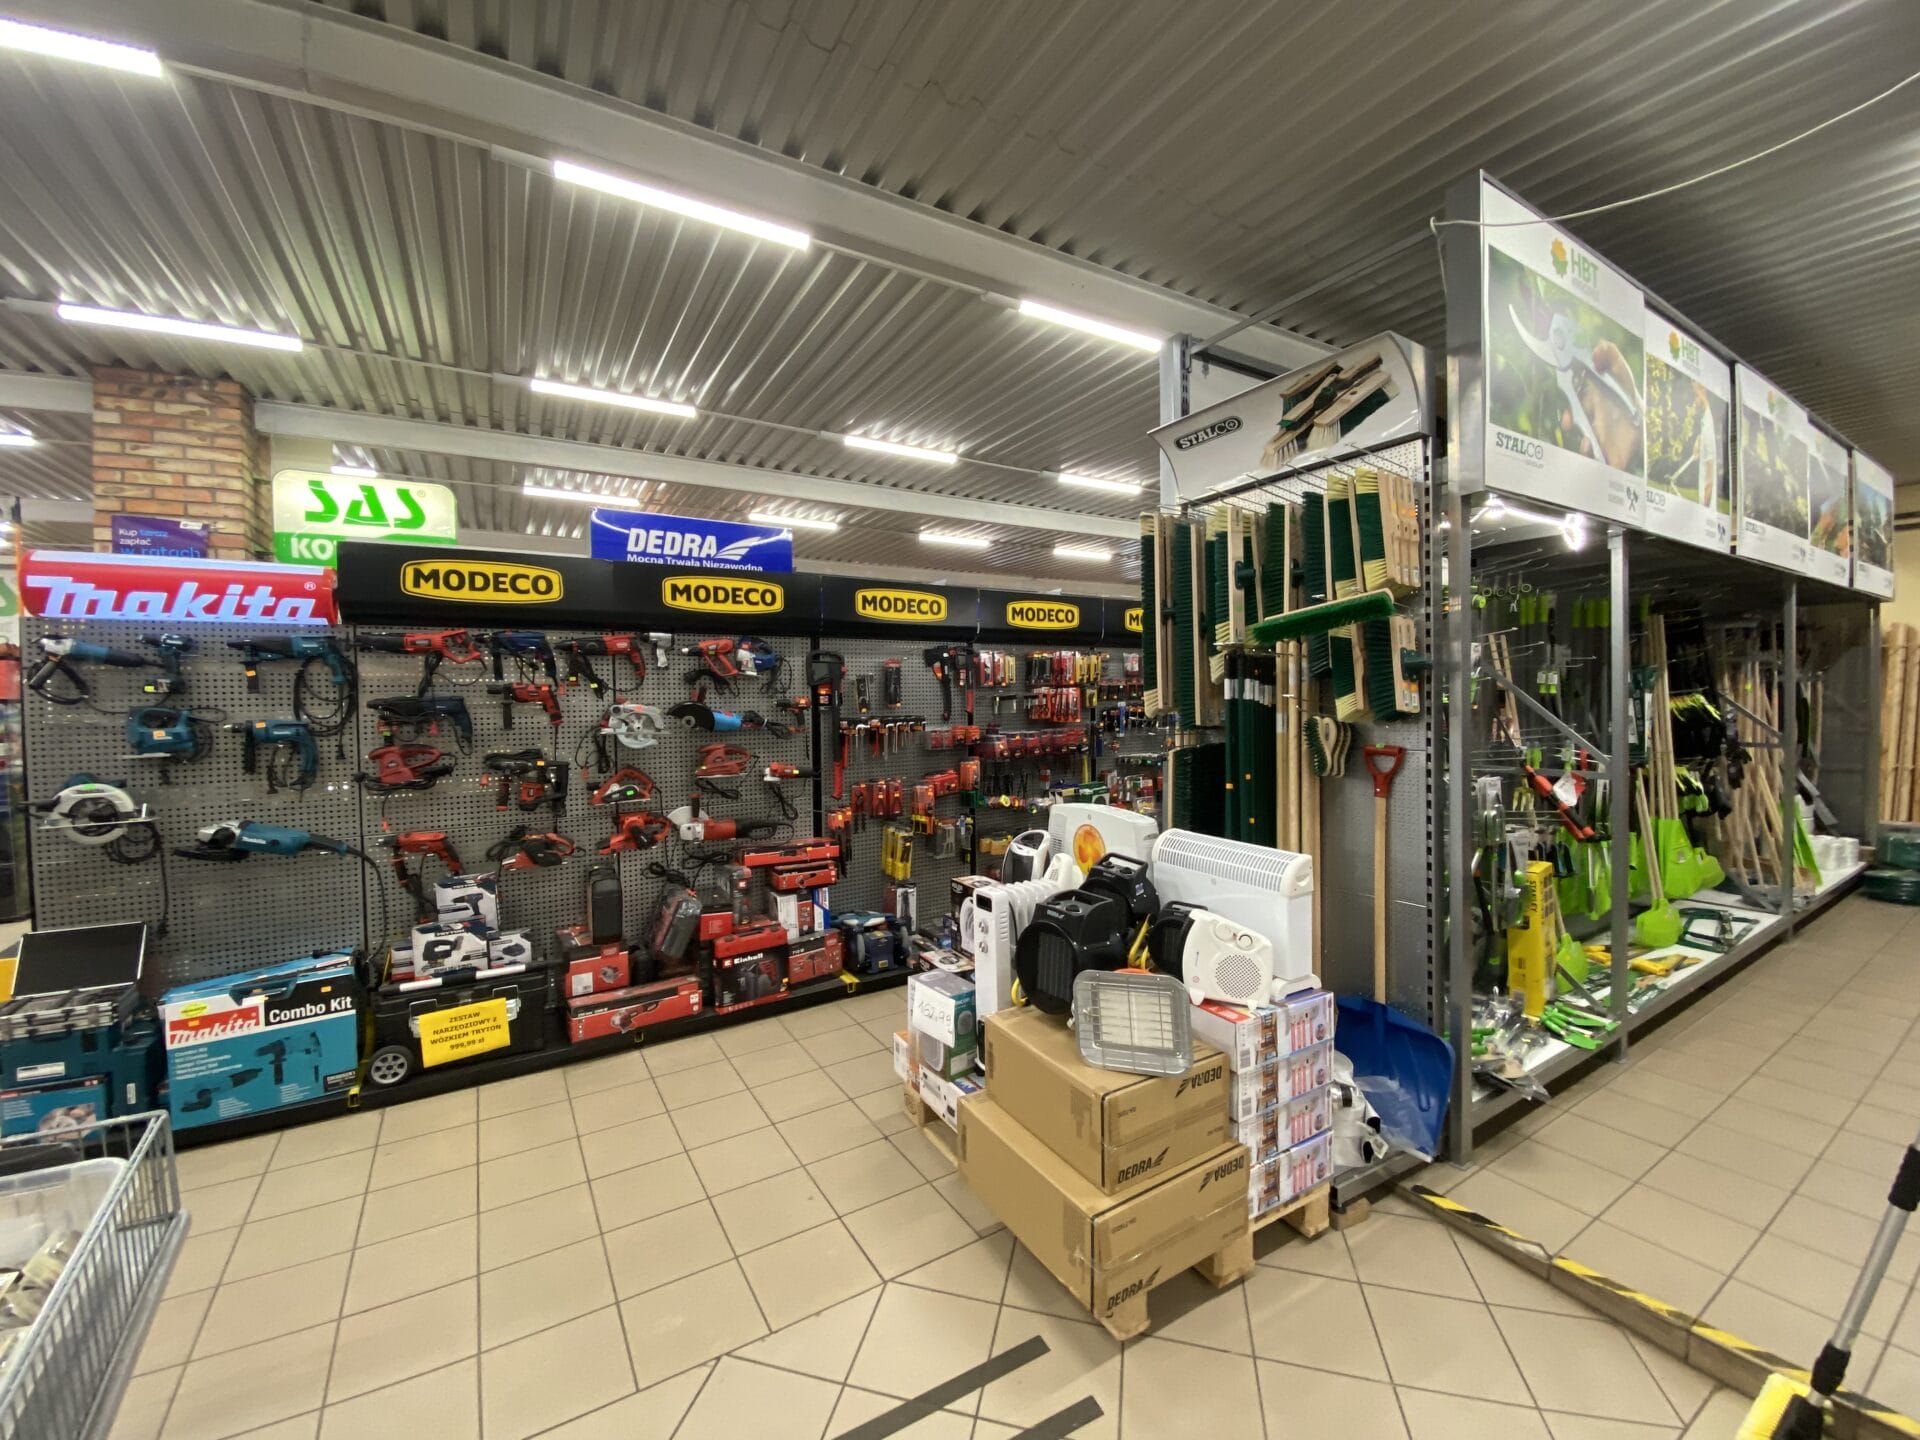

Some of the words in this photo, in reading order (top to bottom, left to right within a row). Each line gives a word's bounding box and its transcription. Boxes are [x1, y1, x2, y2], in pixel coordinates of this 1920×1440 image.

[1571, 248, 1598, 288] HBT
[1180, 419, 1238, 448] STALCO
[1496, 432, 1543, 460] STALCO
[305, 480, 426, 529] SAS
[119, 528, 137, 537] Kup
[627, 528, 718, 558] DEDRA
[291, 537, 337, 560] KO
[627, 554, 663, 564] Mocna
[413, 568, 553, 595] MODECO
[671, 583, 776, 607] MODECO
[861, 595, 941, 616] MODECO
[1011, 607, 1075, 623] MODECO
[269, 1001, 326, 1023] Combo
[330, 996, 352, 1012] Kit
[449, 1012, 480, 1023] ZESTAW
[472, 1025, 501, 1035] TRYTON
[1191, 1066, 1222, 1089] DEDRA
[1118, 1157, 1153, 1184] DEDRA
[1214, 1155, 1245, 1181] DEDRA
[1107, 1279, 1144, 1311] DEDRA
